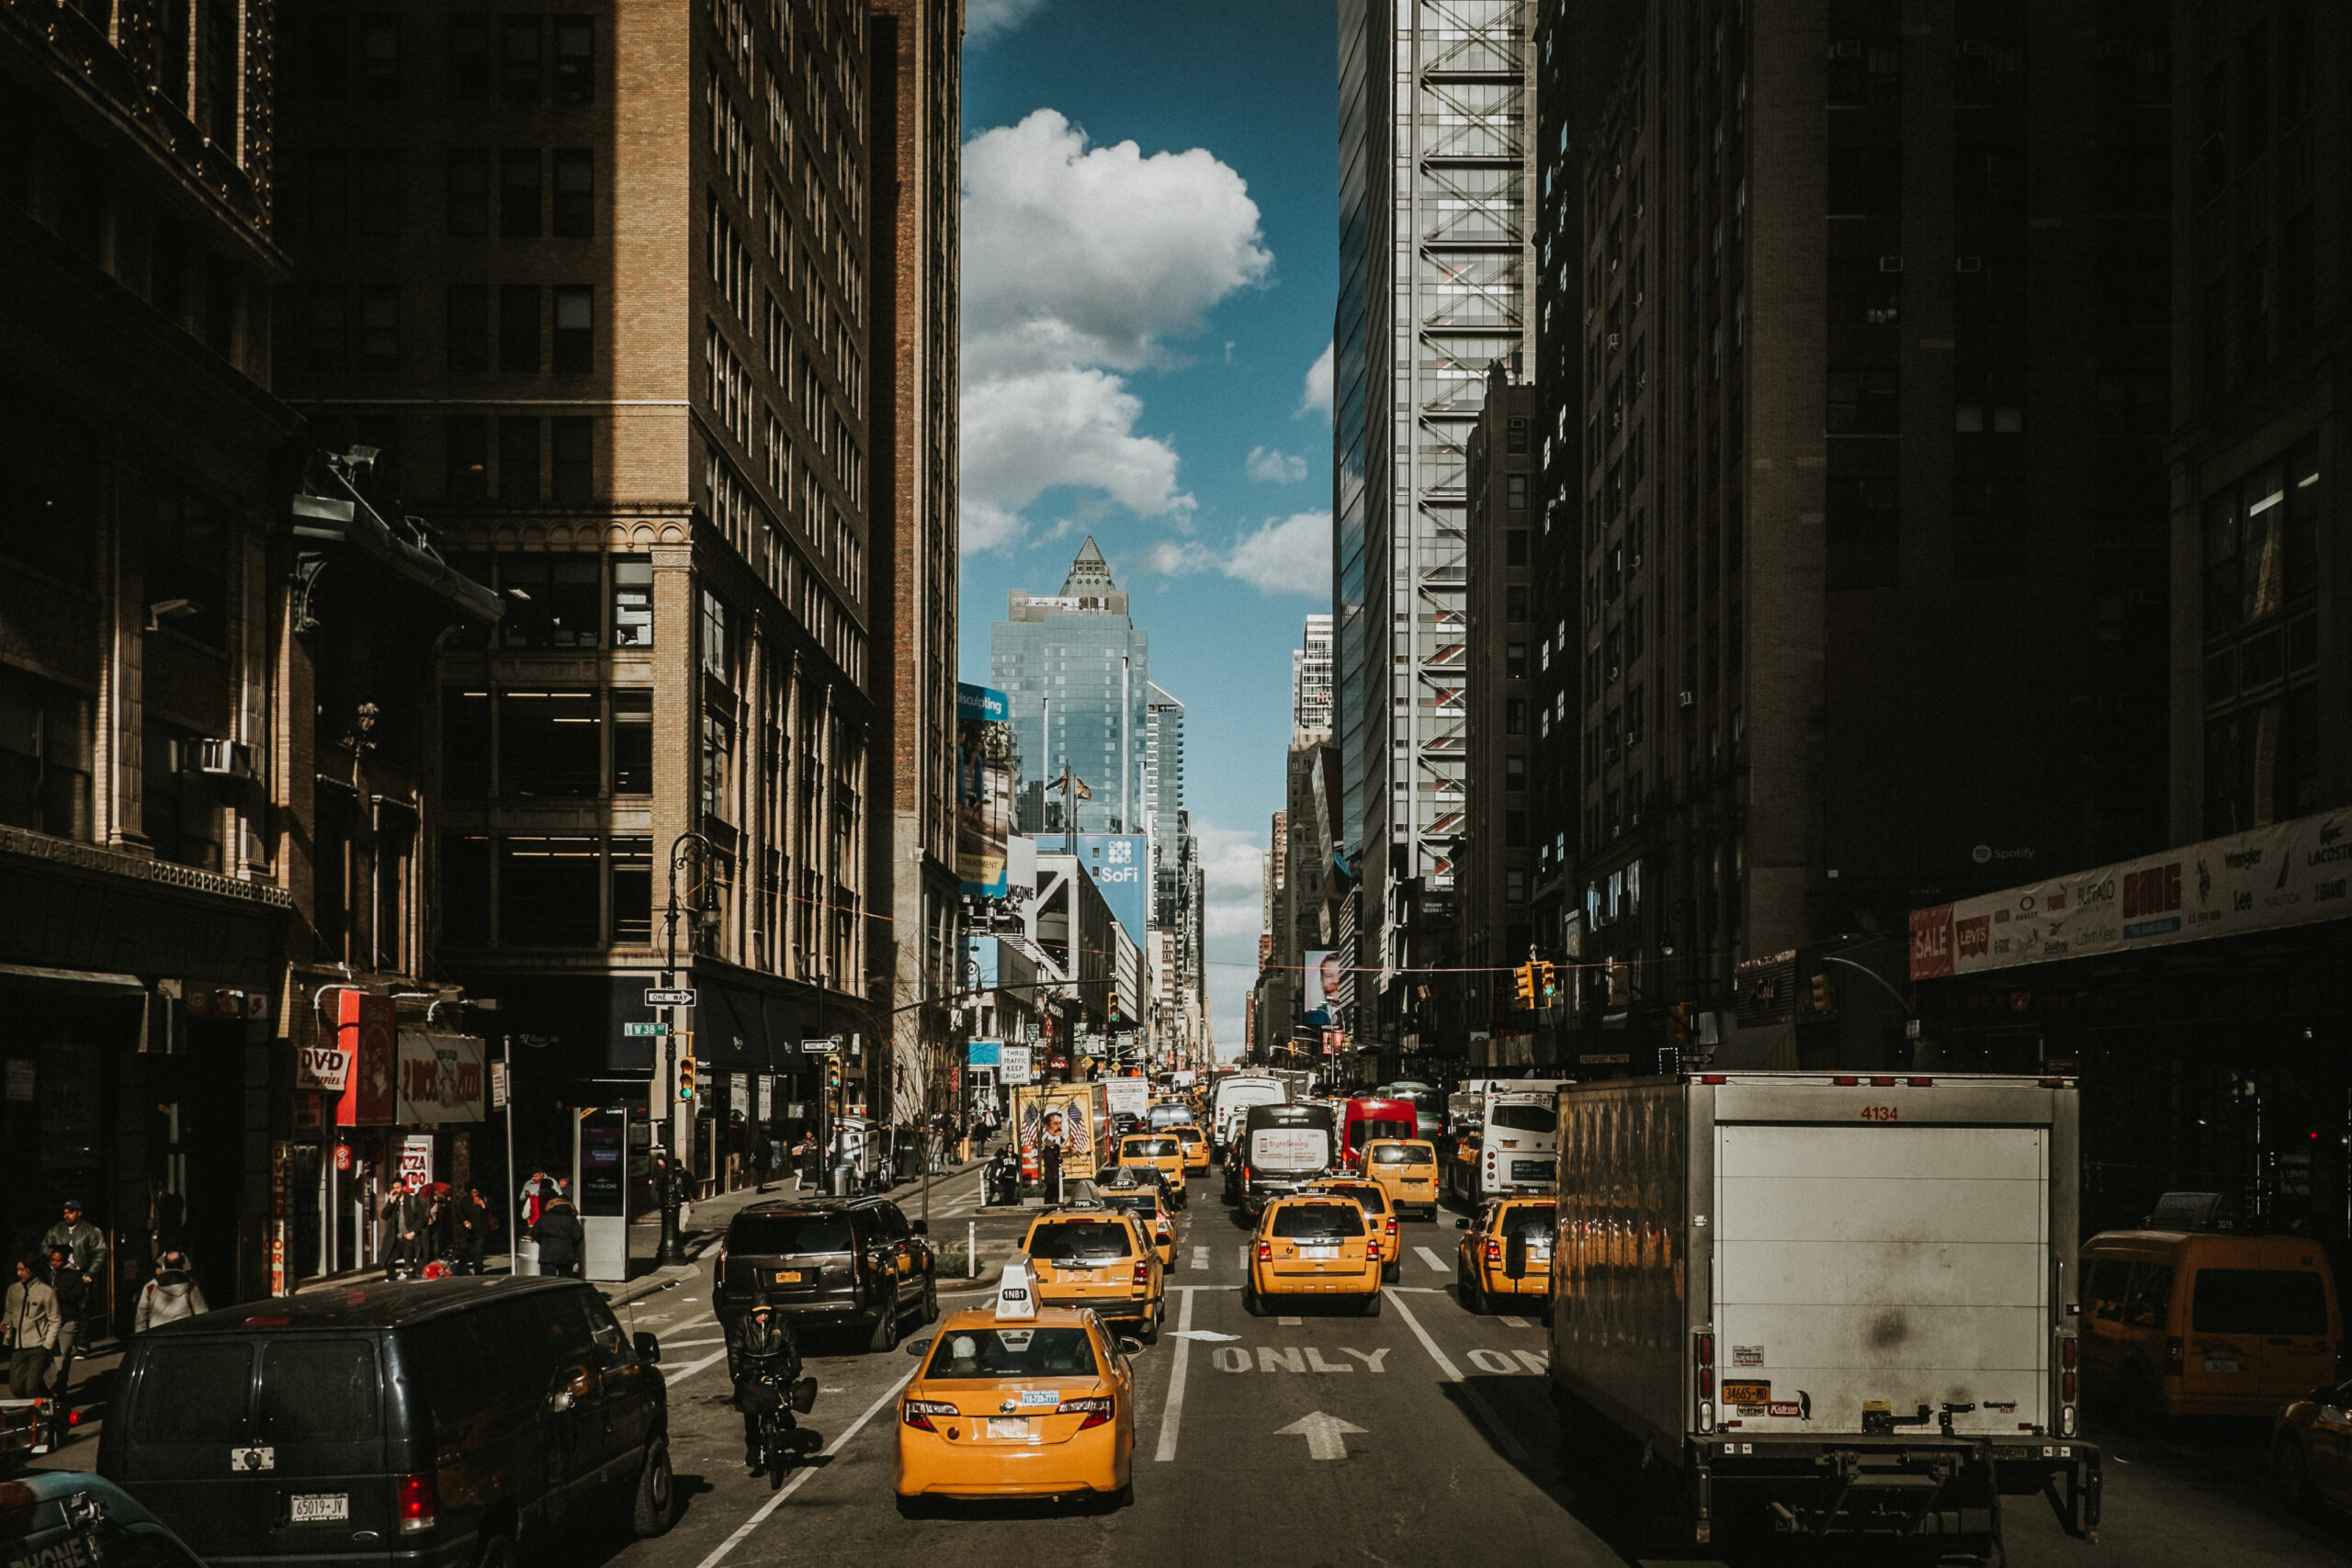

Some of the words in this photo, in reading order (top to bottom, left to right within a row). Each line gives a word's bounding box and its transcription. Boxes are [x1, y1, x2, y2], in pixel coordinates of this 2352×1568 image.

[958, 692, 1002, 715] lsculpting
[1994, 847, 2035, 860] Spotify
[2224, 848, 2262, 870] Wrangler
[1102, 867, 1138, 882] SoFi
[2077, 880, 2115, 906] BUFFALO
[2123, 863, 2181, 919] OMG
[2265, 893, 2301, 908] NAUTICA
[2233, 890, 2252, 912] Lee
[1916, 925, 1947, 959] SALE
[2043, 940, 2069, 956] Reebok
[634, 1024, 643, 1035] W
[643, 1024, 656, 1035] 38
[301, 1049, 344, 1071] DVD
[1860, 1106, 1898, 1121] 4134
[1003, 1290, 1025, 1300] 1N81
[1212, 1346, 1392, 1373] ONLY
[1770, 1404, 1798, 1415] Kidron
